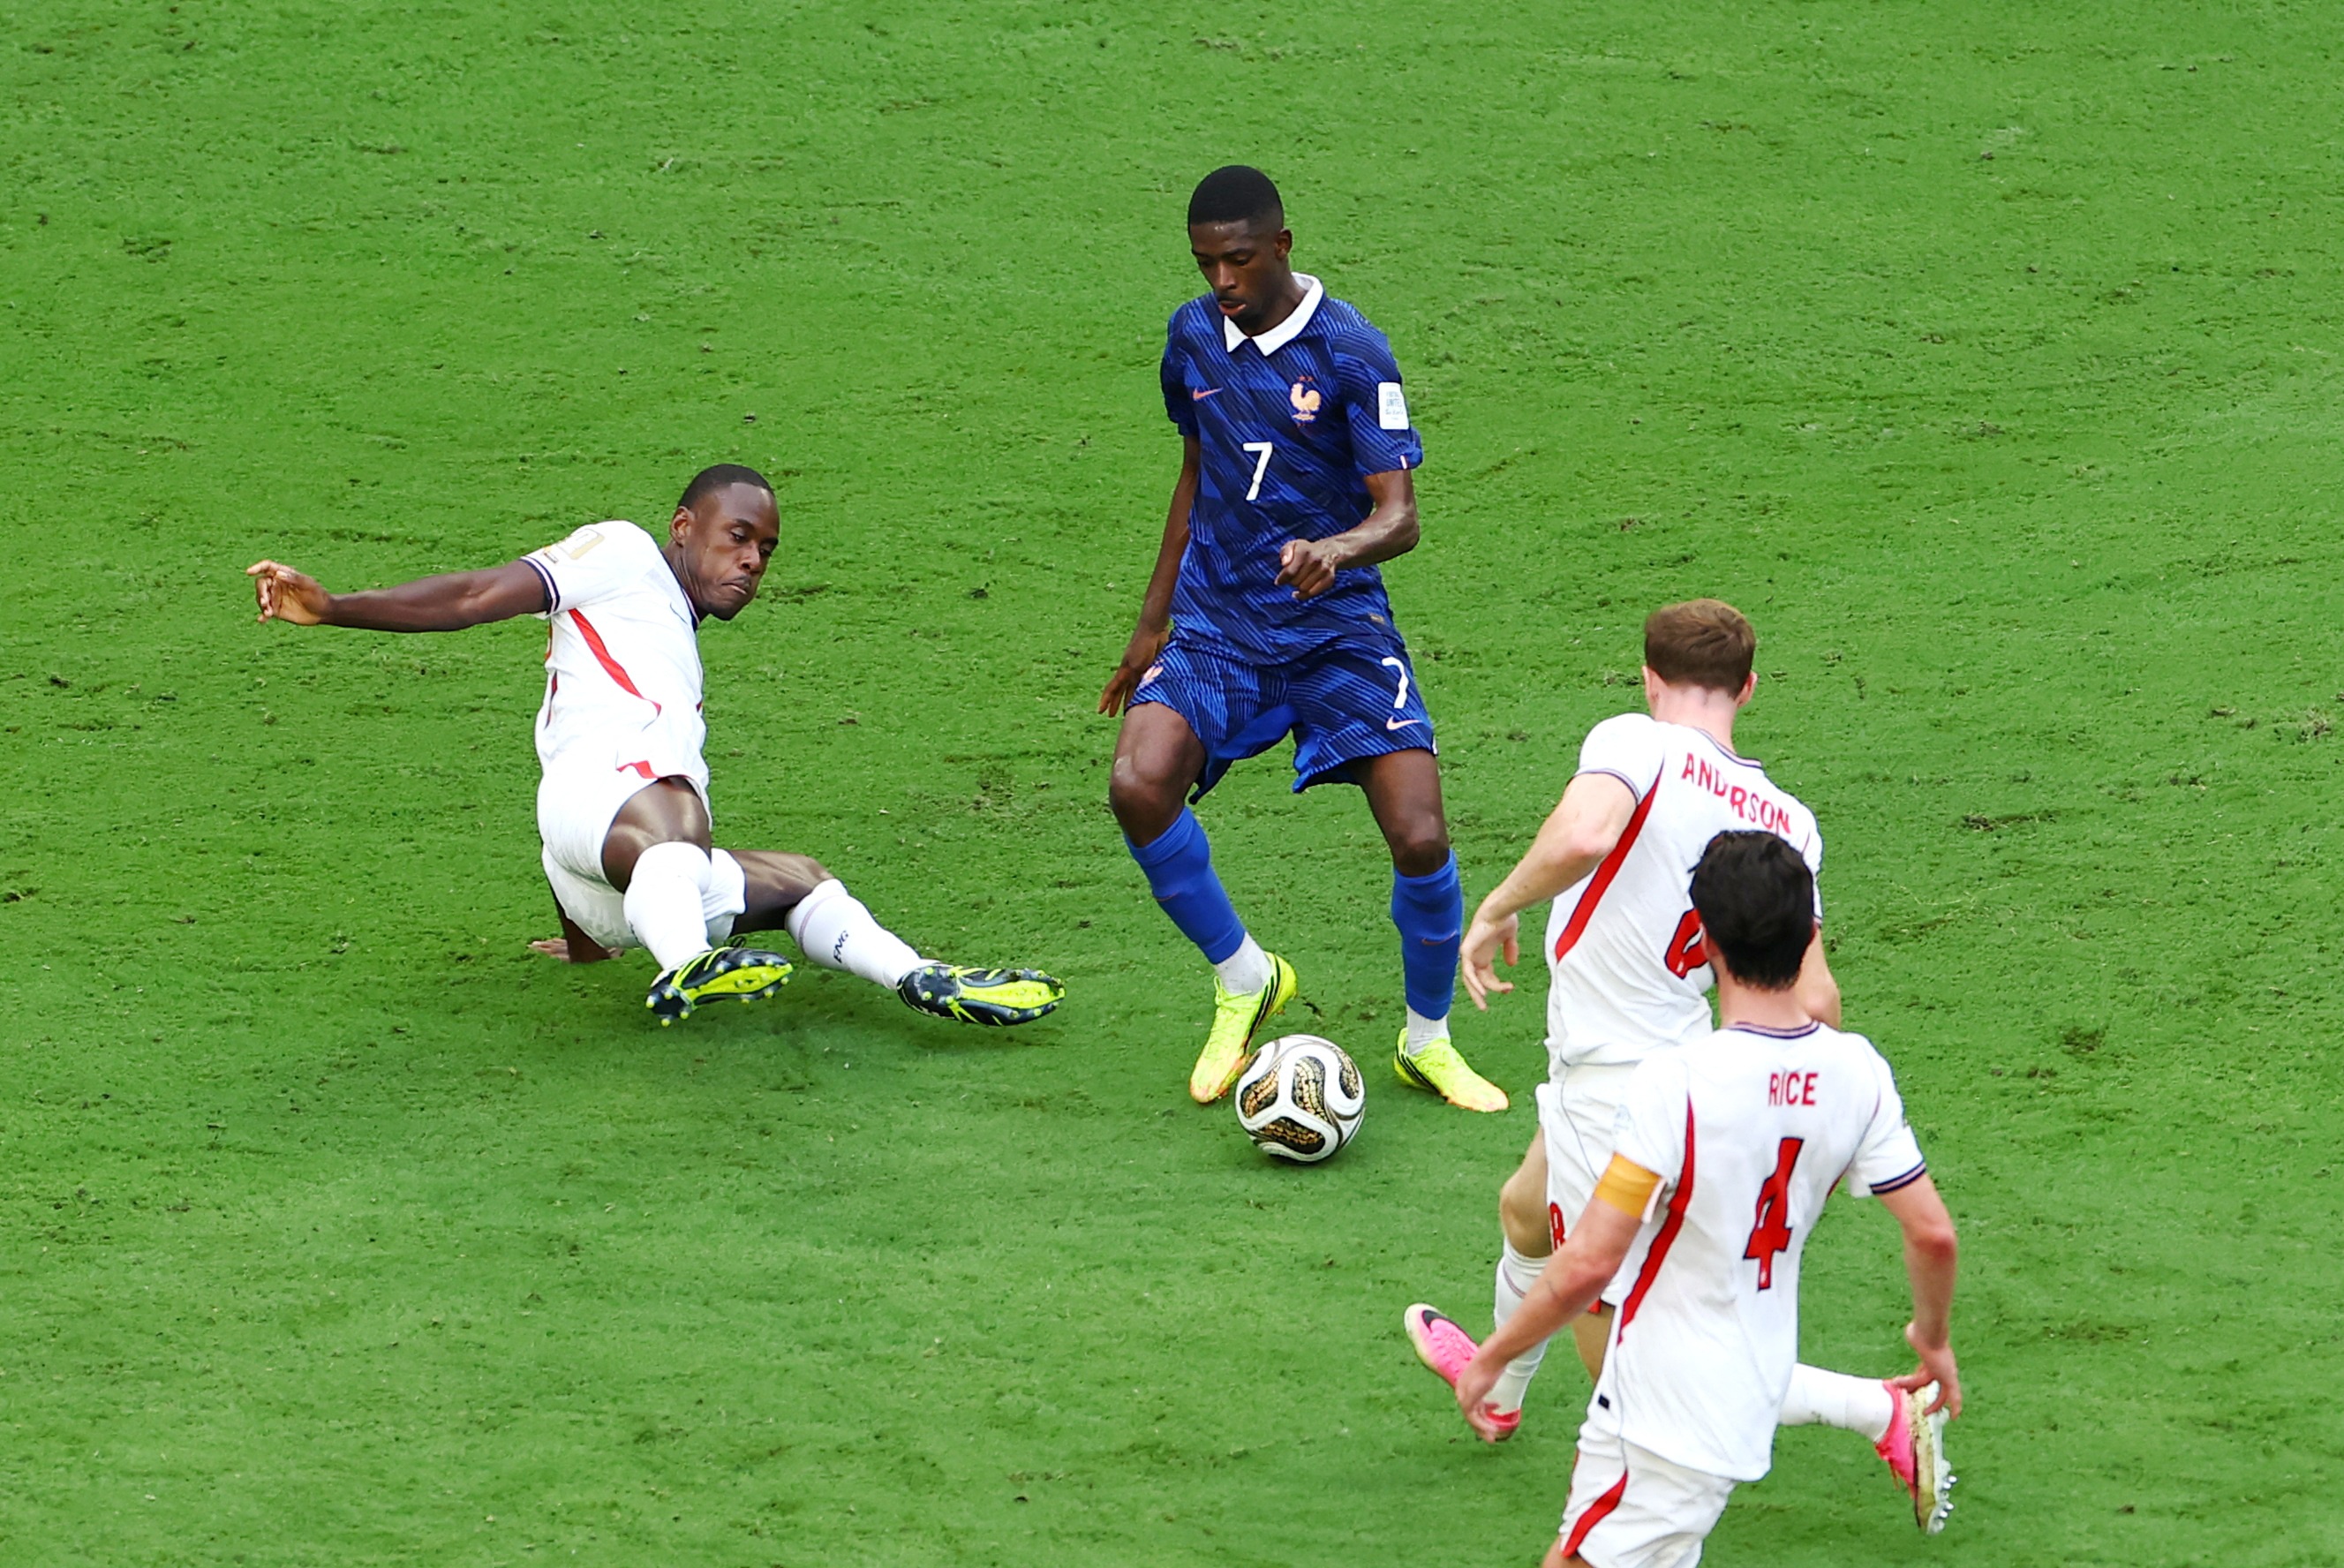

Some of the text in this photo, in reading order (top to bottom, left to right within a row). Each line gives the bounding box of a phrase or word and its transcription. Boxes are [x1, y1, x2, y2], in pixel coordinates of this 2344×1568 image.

[1243, 441, 1273, 501] 7
[1382, 656, 1409, 709] 7
[1681, 752, 1791, 835] ANDRSON
[833, 930, 848, 963] ENG
[1767, 1071, 1819, 1106] RICE
[1743, 1136, 1805, 1292] 4
